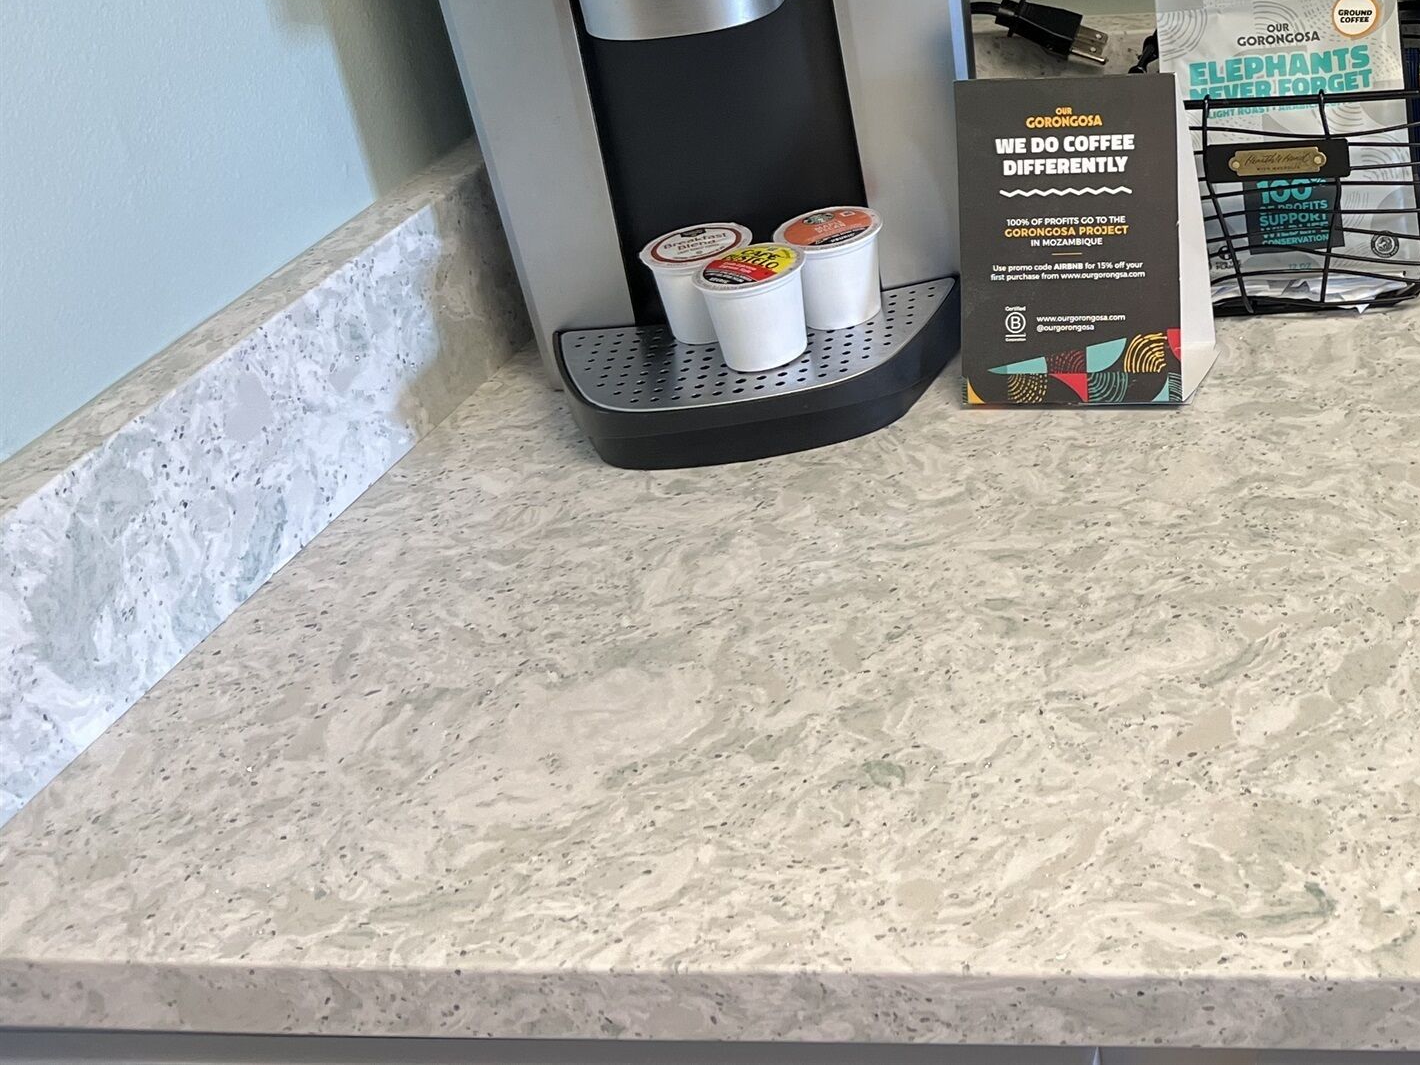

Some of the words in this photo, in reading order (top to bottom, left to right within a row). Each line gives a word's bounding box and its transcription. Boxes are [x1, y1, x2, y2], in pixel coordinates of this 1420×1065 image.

[1338, 8, 1373, 18] GROUND
[1340, 15, 1370, 24] COFFEE
[1266, 23, 1290, 33] OUR
[1237, 30, 1321, 47] GORONGOSA
[1189, 44, 1371, 86] ELEPHANTS
[1189, 78, 1272, 100] NEVER
[1278, 68, 1373, 96] FORGET
[1055, 107, 1073, 115] OUR
[1025, 114, 1103, 129] GORONGOSA
[995, 137, 1027, 155] WE
[1030, 136, 1060, 154] DO
[1063, 134, 1136, 153] COFFEE
[1003, 156, 1129, 176] DIFFERENTLY
[1006, 218, 1030, 227] 100%
[1031, 217, 1043, 226] OF
[1044, 216, 1080, 226] PROFITS
[1081, 216, 1095, 225] GO
[1095, 216, 1108, 224] TO
[1108, 215, 1126, 224] THE
[1004, 227, 1076, 238] GORONGOSA
[1079, 225, 1130, 236] PROJECT
[663, 232, 727, 250] Breakfast
[677, 239, 717, 251] Blend
[1030, 239, 1041, 247] IN
[1042, 237, 1104, 247] MOZAMBIQUE
[992, 264, 1007, 273] Use
[1008, 265, 1033, 273] promo
[1034, 263, 1053, 272] code
[1053, 262, 1084, 271] AIRBNB
[1085, 262, 1096, 270] for
[1097, 262, 1113, 270] 15%
[1114, 261, 1125, 269] off
[1126, 262, 1144, 271] your
[990, 273, 1005, 281] first
[1006, 273, 1041, 283] purchase
[1041, 272, 1060, 281] from
[1010, 315, 1021, 330] B
[1036, 314, 1126, 323] www.ourgorongosa.com
[1036, 323, 1095, 333] @ourgorongosa
